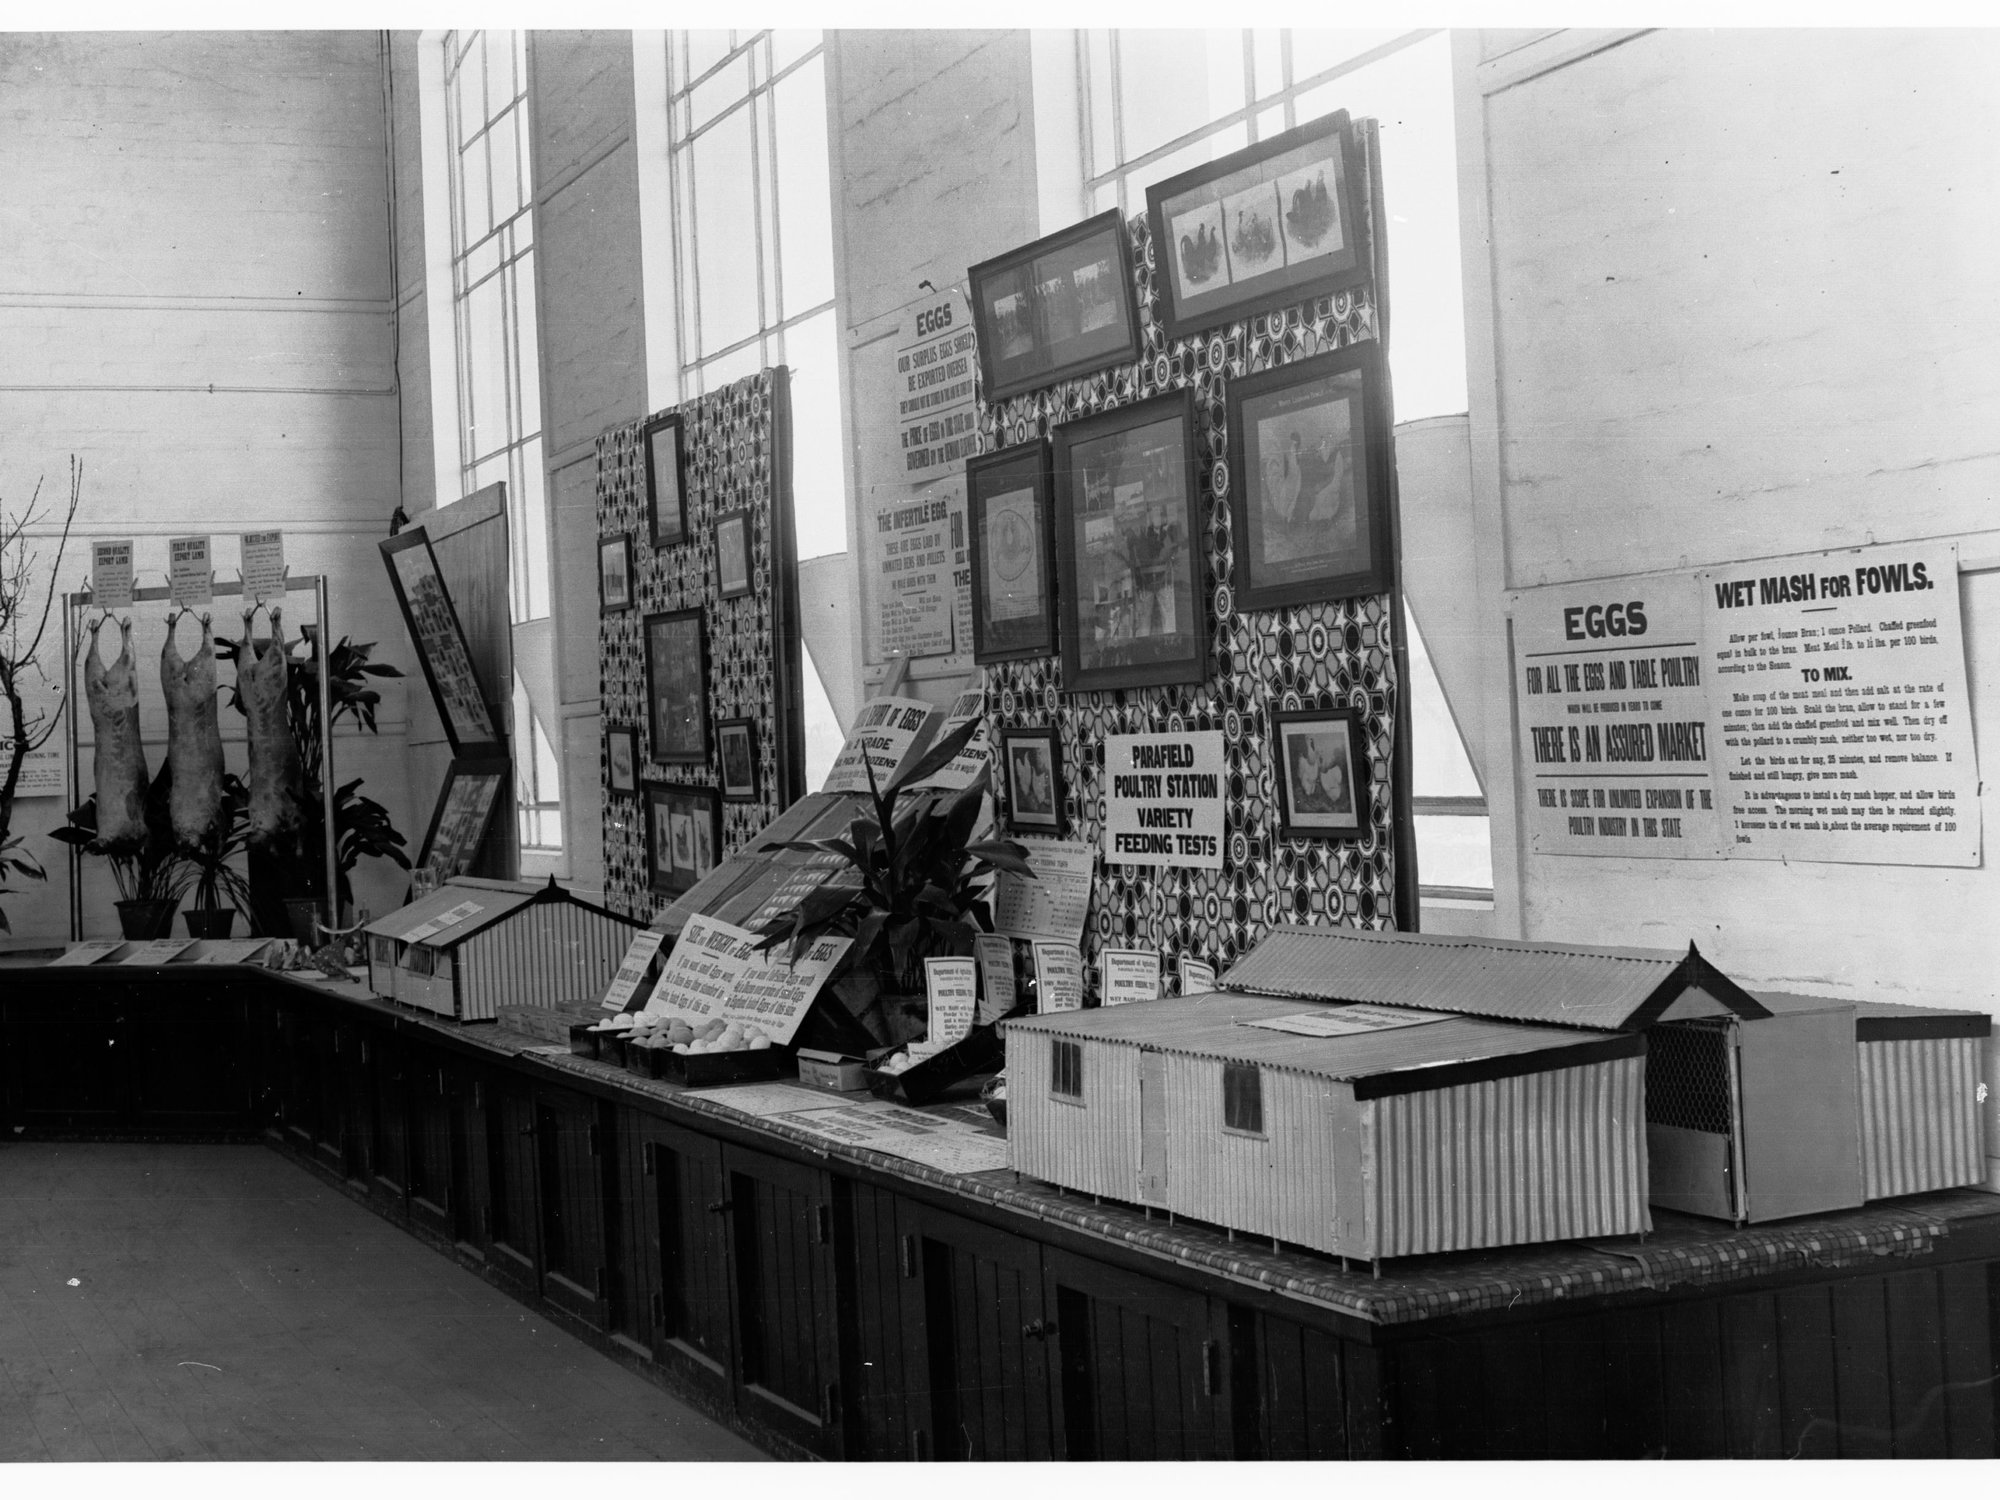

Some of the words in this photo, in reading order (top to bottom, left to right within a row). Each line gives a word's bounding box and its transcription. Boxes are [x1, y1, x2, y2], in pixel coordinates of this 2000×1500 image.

[916, 303, 952, 337] EGGS
[898, 355, 910, 373] OUR
[912, 346, 937, 369] SURPLUS
[939, 340, 953, 359] EGGS
[908, 375, 916, 392] BE
[917, 365, 946, 389] EXPORTED
[877, 513, 892, 532] THE
[893, 505, 930, 529] INFERTILE
[931, 501, 947, 521] EGG.
[950, 510, 964, 550] FOR
[953, 568, 970, 587] THE
[1715, 580, 1755, 609] WET
[1760, 573, 1816, 605] MASH
[1820, 575, 1851, 599] FOR
[1856, 562, 1934, 595] FOWLS.
[1564, 601, 1648, 641] EGGS
[1526, 667, 1543, 694] FOR
[1547, 665, 1562, 693] ALL
[1564, 664, 1581, 692] THE
[1583, 662, 1605, 691] EGGS
[1609, 660, 1627, 690] AND
[1629, 659, 1658, 689] TABLE
[1661, 656, 1700, 687] POULTRY
[1801, 669, 1820, 682] TO
[1824, 666, 1852, 681] MIX.
[1733, 693, 1749, 702] Make
[1753, 694, 1766, 702] soup
[1770, 691, 1776, 700] of
[1779, 691, 1789, 699] the
[1793, 691, 1808, 699] meat
[1812, 688, 1827, 698] meal
[1830, 688, 1842, 697] and
[1845, 687, 1859, 696] then
[1862, 686, 1874, 695] add
[1877, 685, 1889, 694] salt
[1904, 684, 1915, 693] the
[1919, 685, 1933, 693] rate
[1937, 683, 1944, 692] of
[886, 707, 902, 727] OF
[898, 707, 926, 732] EGGS
[1755, 707, 1763, 716] for
[1767, 706, 1777, 715] 100
[1781, 706, 1798, 714] birds.
[1804, 705, 1822, 713] Scald
[1825, 704, 1835, 712] the
[1838, 703, 1855, 712] bran,
[1858, 702, 1875, 711] allow
[1889, 700, 1907, 710] stand
[1911, 700, 1920, 709] for
[1933, 699, 1945, 708] few
[1724, 723, 1749, 732] minutes;
[1752, 722, 1765, 730] then
[1768, 721, 1780, 730] add
[1782, 721, 1792, 729] the
[1795, 720, 1817, 729] chaffed
[1819, 718, 1849, 730] greenfood
[1852, 718, 1864, 727] and
[1868, 718, 1880, 726] mix
[1884, 716, 1899, 726] well.
[1903, 716, 1920, 725] Then
[1924, 716, 1935, 726] dry
[1939, 715, 1947, 724] off
[1531, 726, 1566, 763] THERE
[1568, 726, 1581, 762] IS
[1586, 725, 1601, 762] AN
[1606, 723, 1654, 762] ASSURED
[1657, 722, 1706, 761] MARKET
[1725, 737, 1739, 746] with
[1741, 737, 1751, 746] the
[1753, 736, 1774, 747] pollard
[1776, 737, 1783, 745] to
[1793, 735, 1817, 745] crumbly
[1841, 734, 1864, 743] neither
[1866, 734, 1877, 742] too
[1879, 733, 1894, 743] wet,
[1896, 734, 1907, 742] nor
[1910, 733, 1920, 741] too
[1924, 731, 1937, 742] dry.
[1132, 744, 1194, 769] PARAFIELD
[1114, 775, 1162, 798] POULTRY
[1167, 774, 1218, 798] STATION
[1537, 788, 1557, 808] THERE
[1560, 789, 1567, 808] IS
[1570, 789, 1590, 808] SCOPE
[1593, 789, 1606, 808] FOR
[1608, 789, 1642, 809] UNLIMITED
[1645, 789, 1682, 809] EXPANSION
[1686, 789, 1694, 810] OF
[1699, 789, 1713, 810] THE
[1137, 808, 1193, 828] VARIETY
[1568, 816, 1594, 835] POULTRY
[1598, 817, 1627, 836] INDUSTRY
[1631, 817, 1639, 837] IN
[1643, 817, 1657, 838] THIS
[1661, 817, 1682, 838] STATE
[1115, 833, 1173, 854] FEEDING
[1176, 834, 1217, 856] TESTS
[685, 924, 705, 944] SIZE
[704, 930, 738, 953] WEIGHT
[810, 942, 838, 962] EGGS
